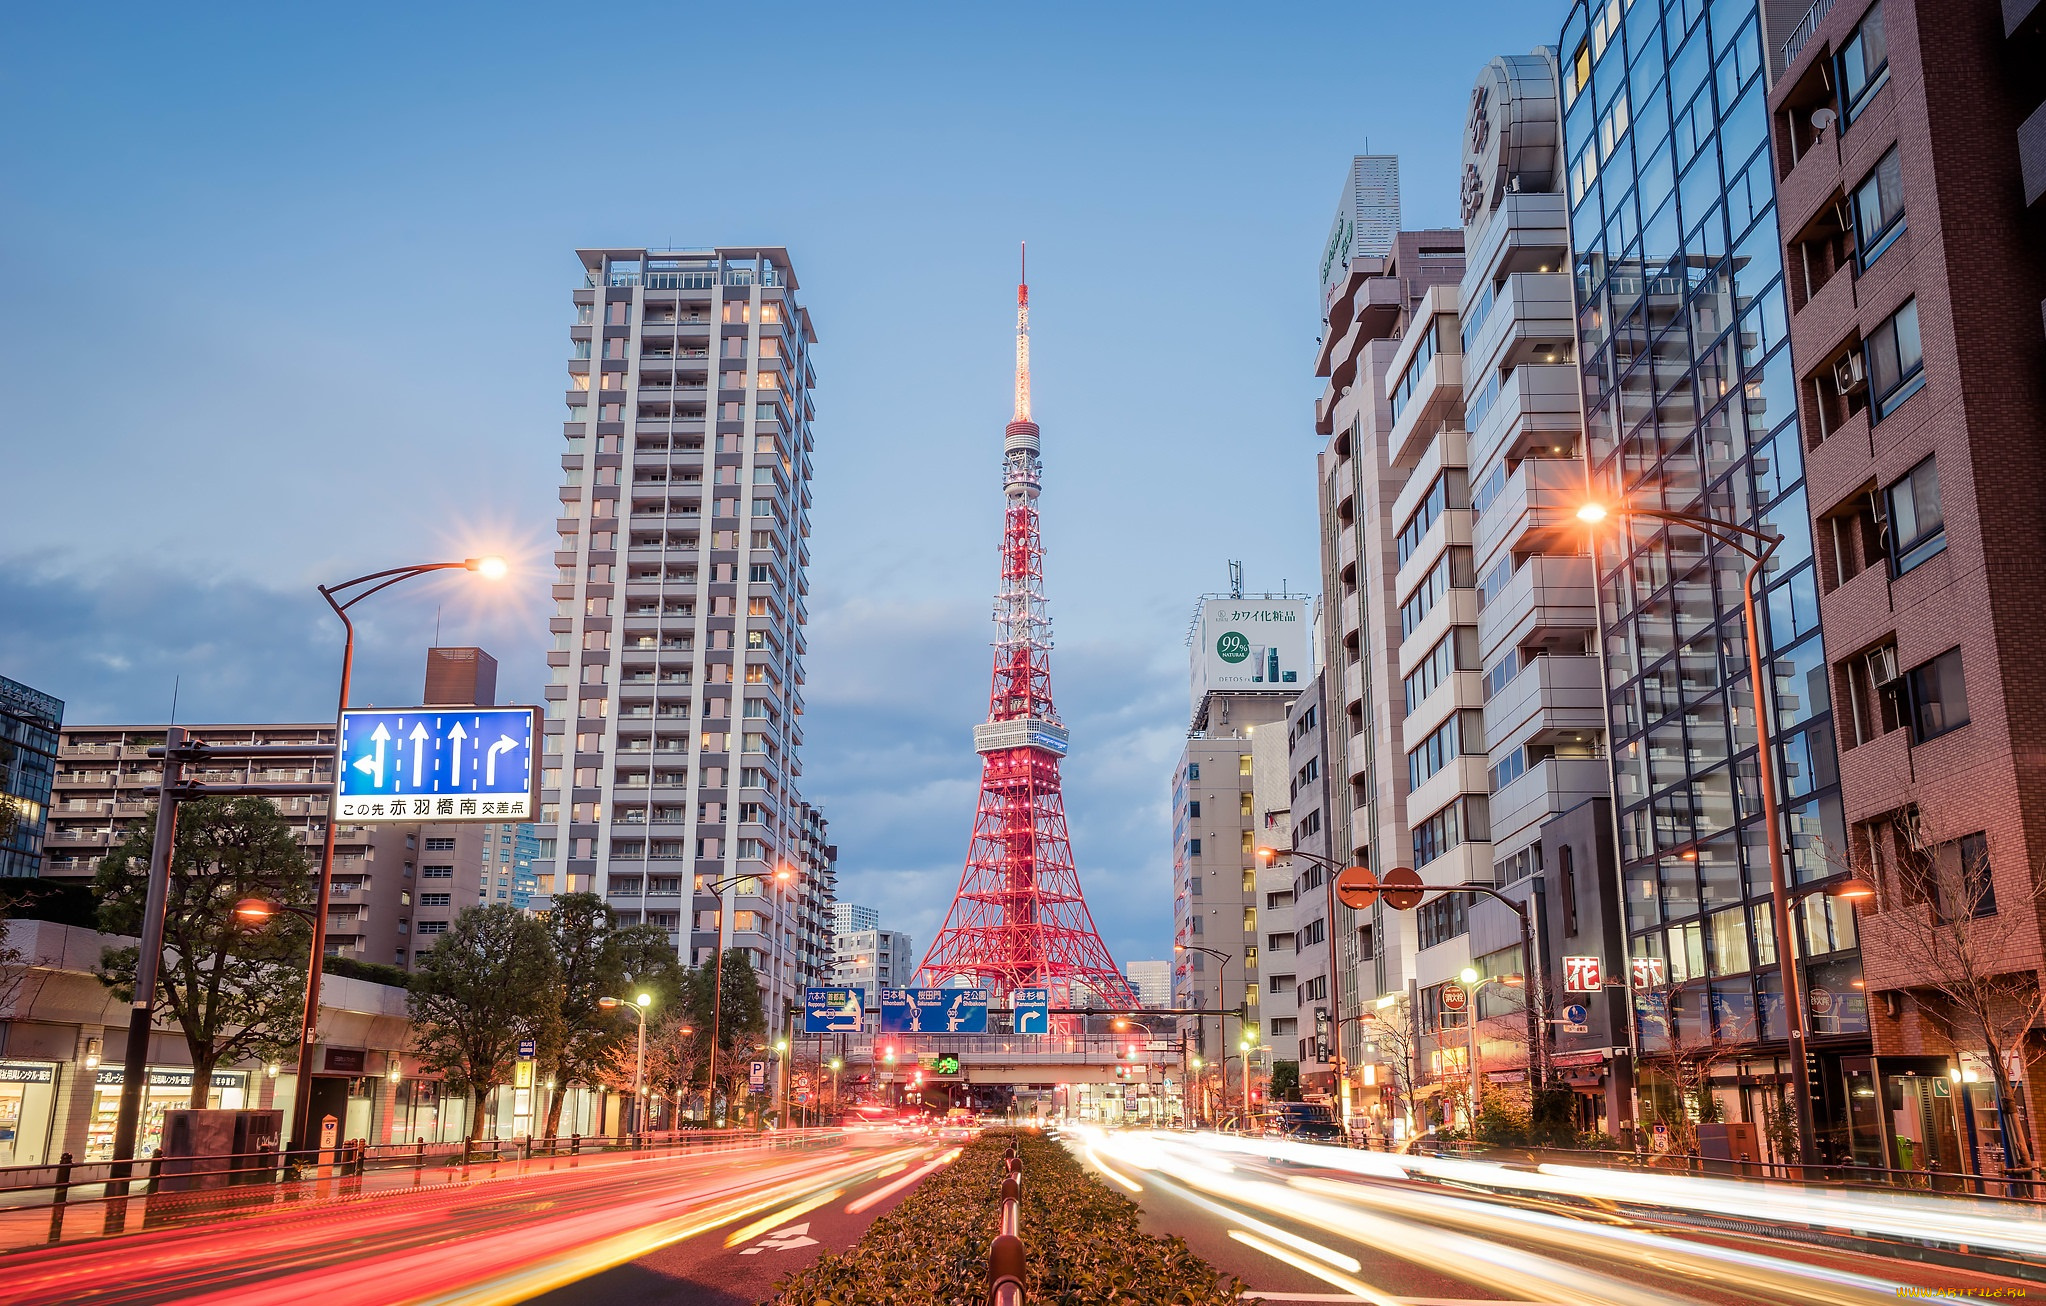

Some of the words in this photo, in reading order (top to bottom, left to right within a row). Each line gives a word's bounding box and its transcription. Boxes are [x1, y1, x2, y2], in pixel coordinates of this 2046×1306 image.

[1231, 610, 1296, 622] カワイ化粧品
[1221, 636, 1248, 653] 99%
[1567, 958, 1600, 990] 花
[807, 991, 826, 1001] 六本木
[882, 990, 906, 1000] 日本橋
[917, 990, 942, 1000] 桜田門
[962, 990, 987, 1001] 芝公園
[1016, 991, 1046, 1001] 金杉橋
[1445, 993, 1464, 1003] 消火栓
[753, 1063, 762, 1075] P
